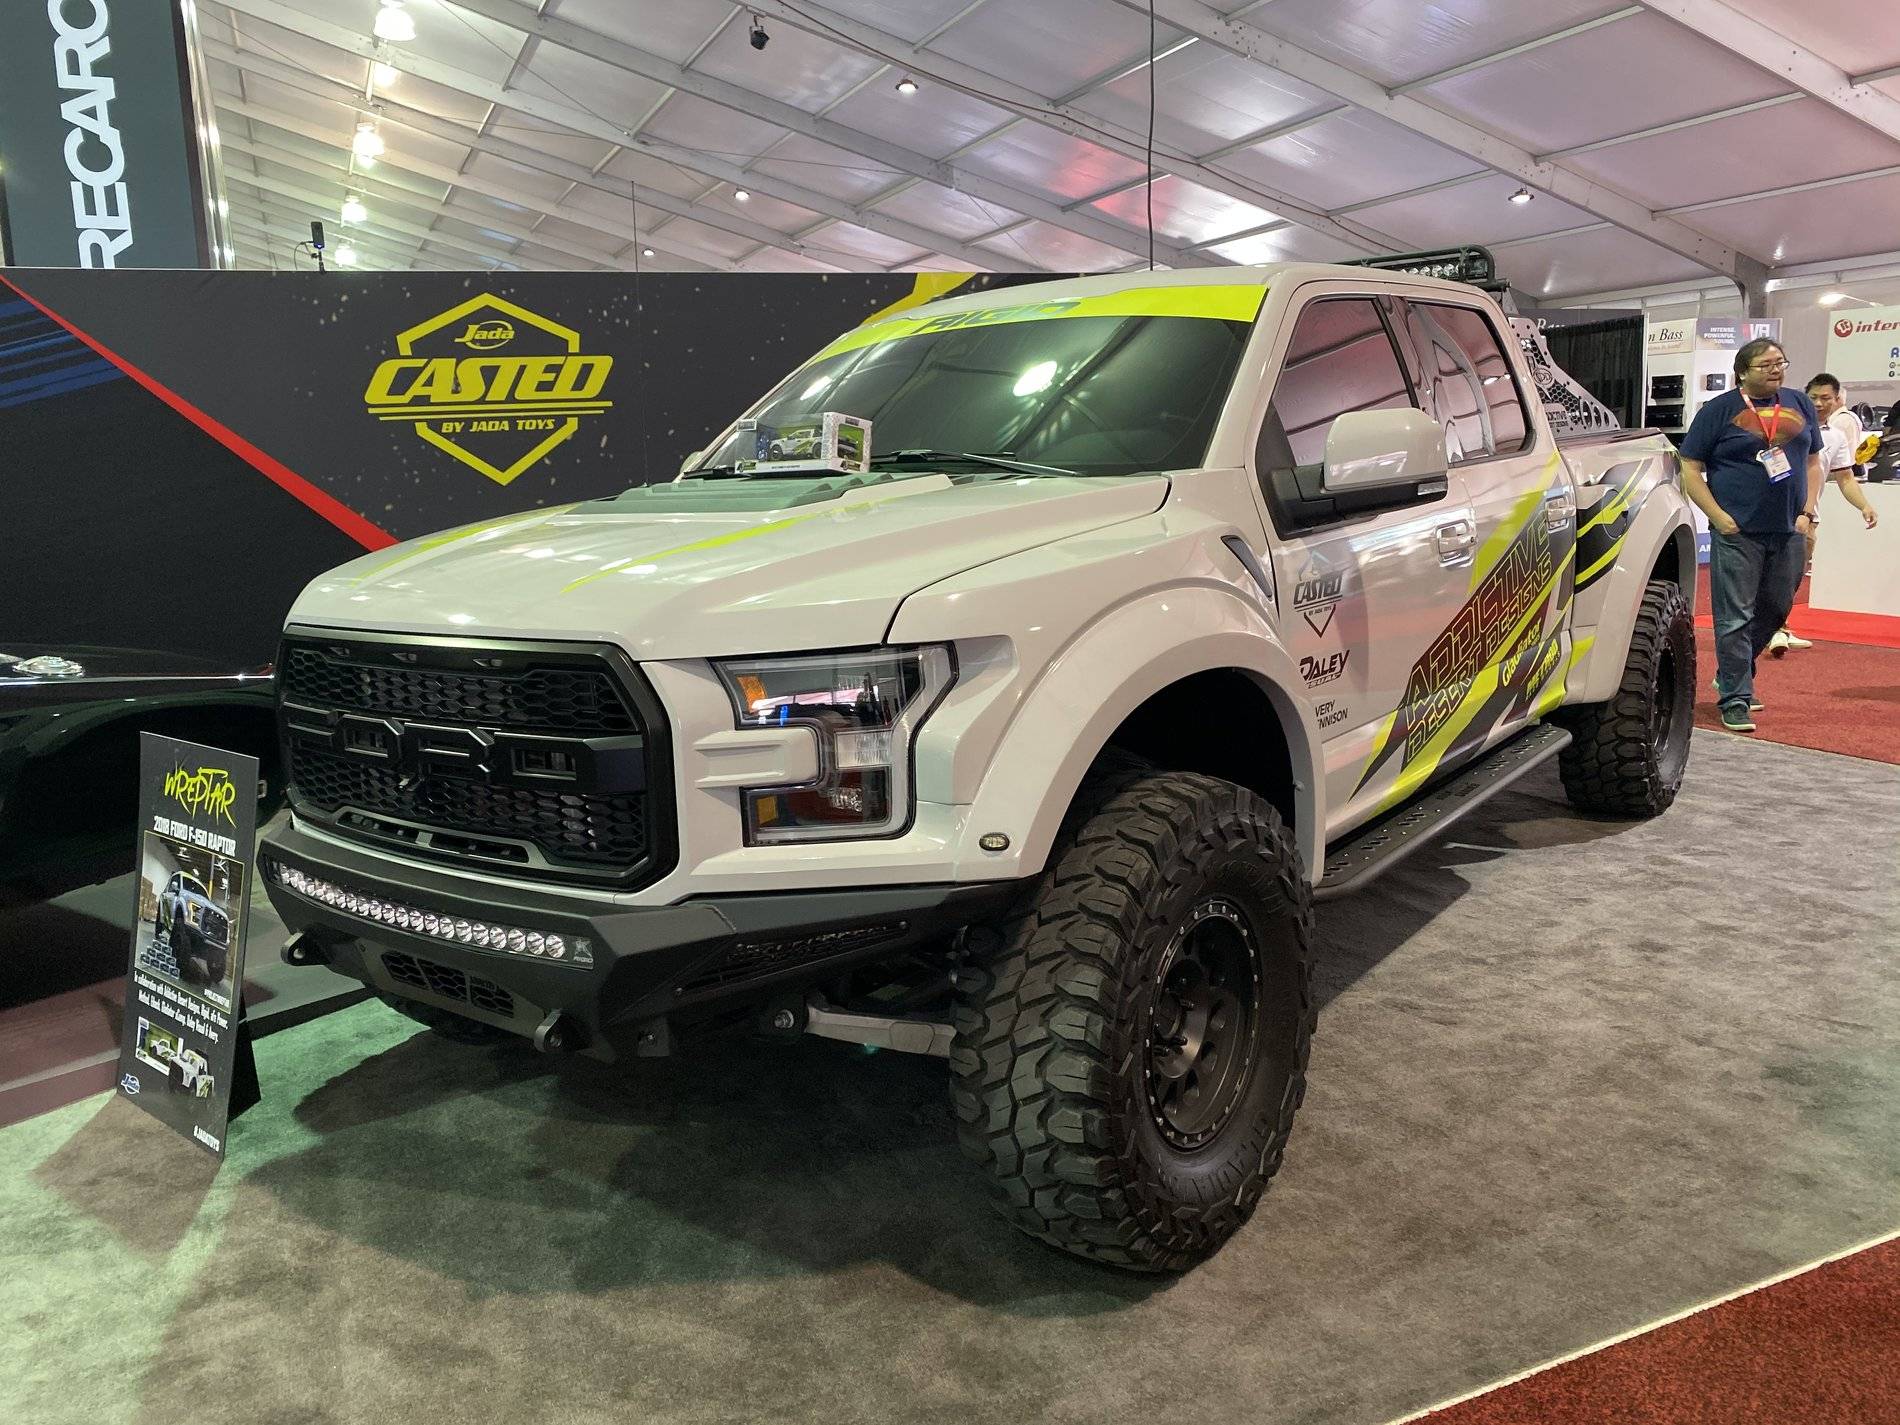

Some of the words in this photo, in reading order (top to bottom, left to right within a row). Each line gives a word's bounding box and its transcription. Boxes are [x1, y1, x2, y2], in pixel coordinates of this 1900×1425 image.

[48, 0, 133, 268] RECARO
[455, 321, 515, 346] Jada
[1660, 327, 1684, 341] Bass
[364, 355, 614, 405] CASTED
[441, 421, 465, 434] BY
[469, 419, 510, 433] JADA
[516, 418, 556, 431] TOYS
[1486, 551, 1551, 661] DESIGNS
[1405, 508, 1551, 732] ADDICTIVE
[1299, 649, 1350, 681] DALEY
[1315, 700, 1335, 717] VERY
[1318, 708, 1348, 729] NNISON
[207, 832, 236, 857] RAPTOR
